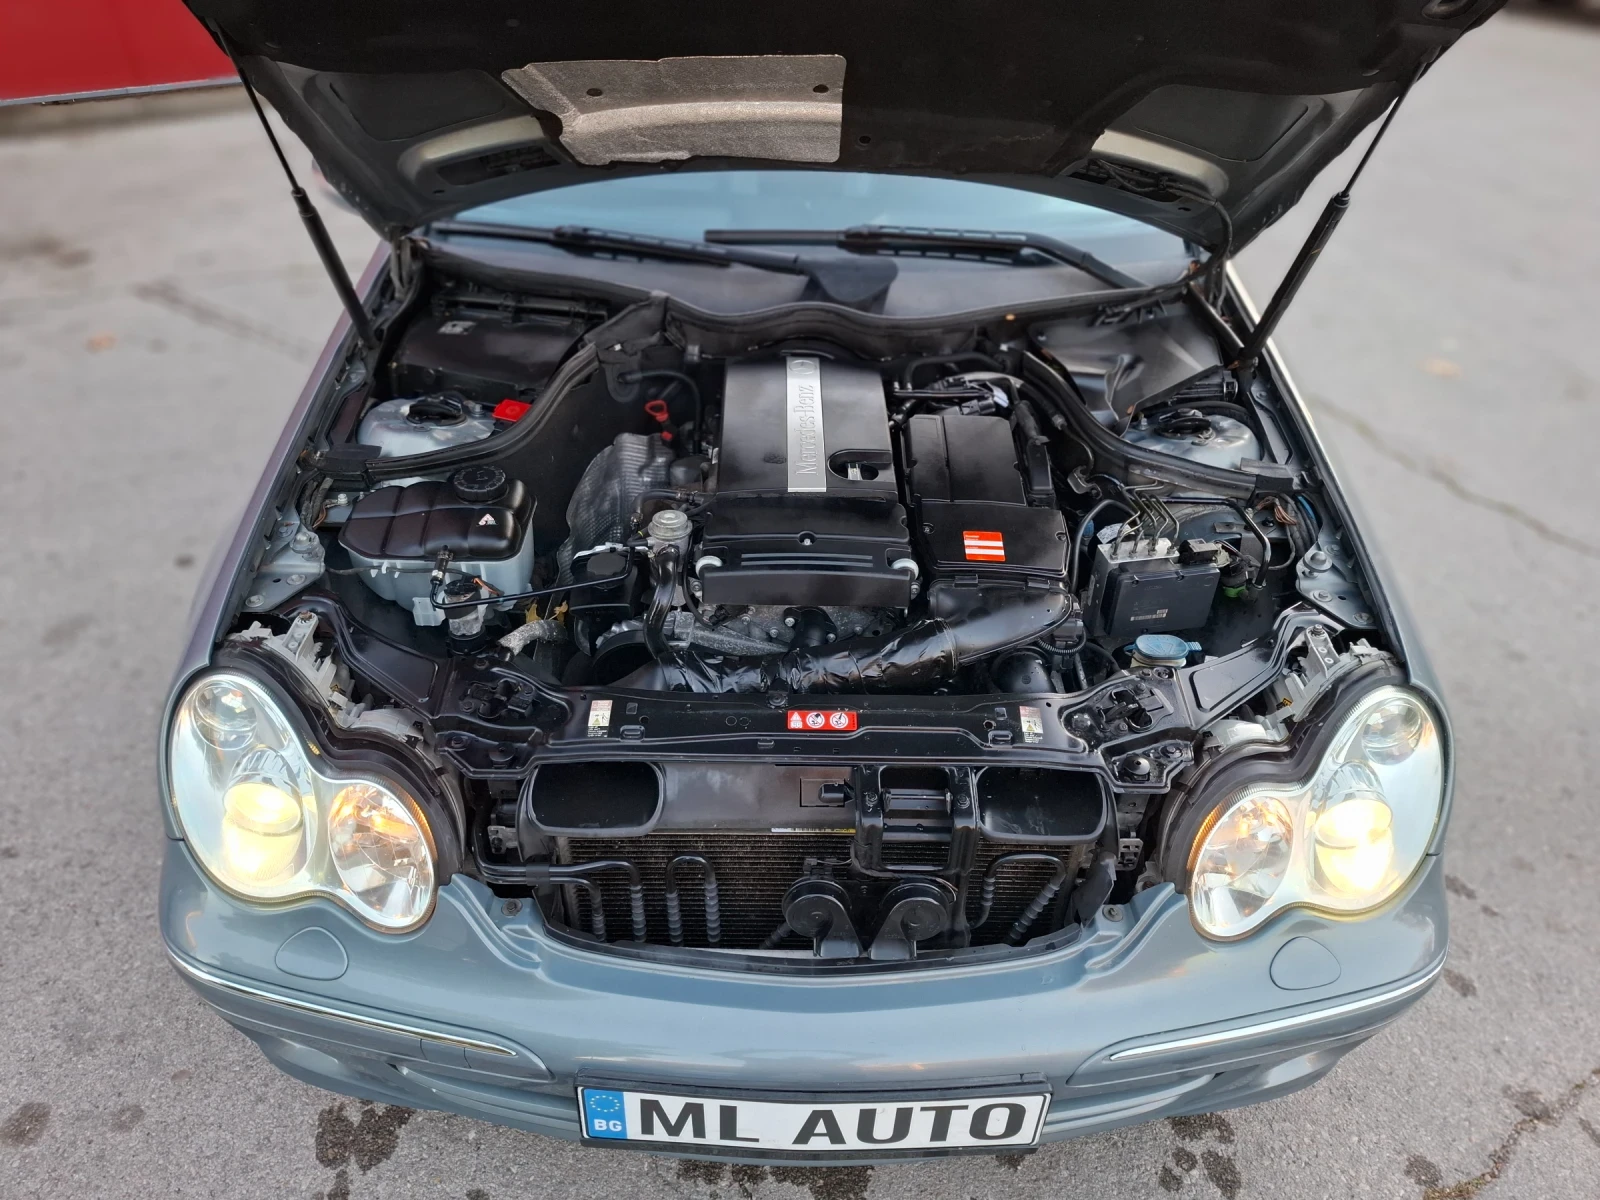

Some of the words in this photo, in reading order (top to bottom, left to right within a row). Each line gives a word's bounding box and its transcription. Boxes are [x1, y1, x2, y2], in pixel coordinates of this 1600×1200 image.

[794, 385, 818, 475] Mercedes-Benz
[594, 1119, 622, 1132] BG
[640, 1098, 760, 1143] ML
[791, 1102, 1027, 1145] AUTO
